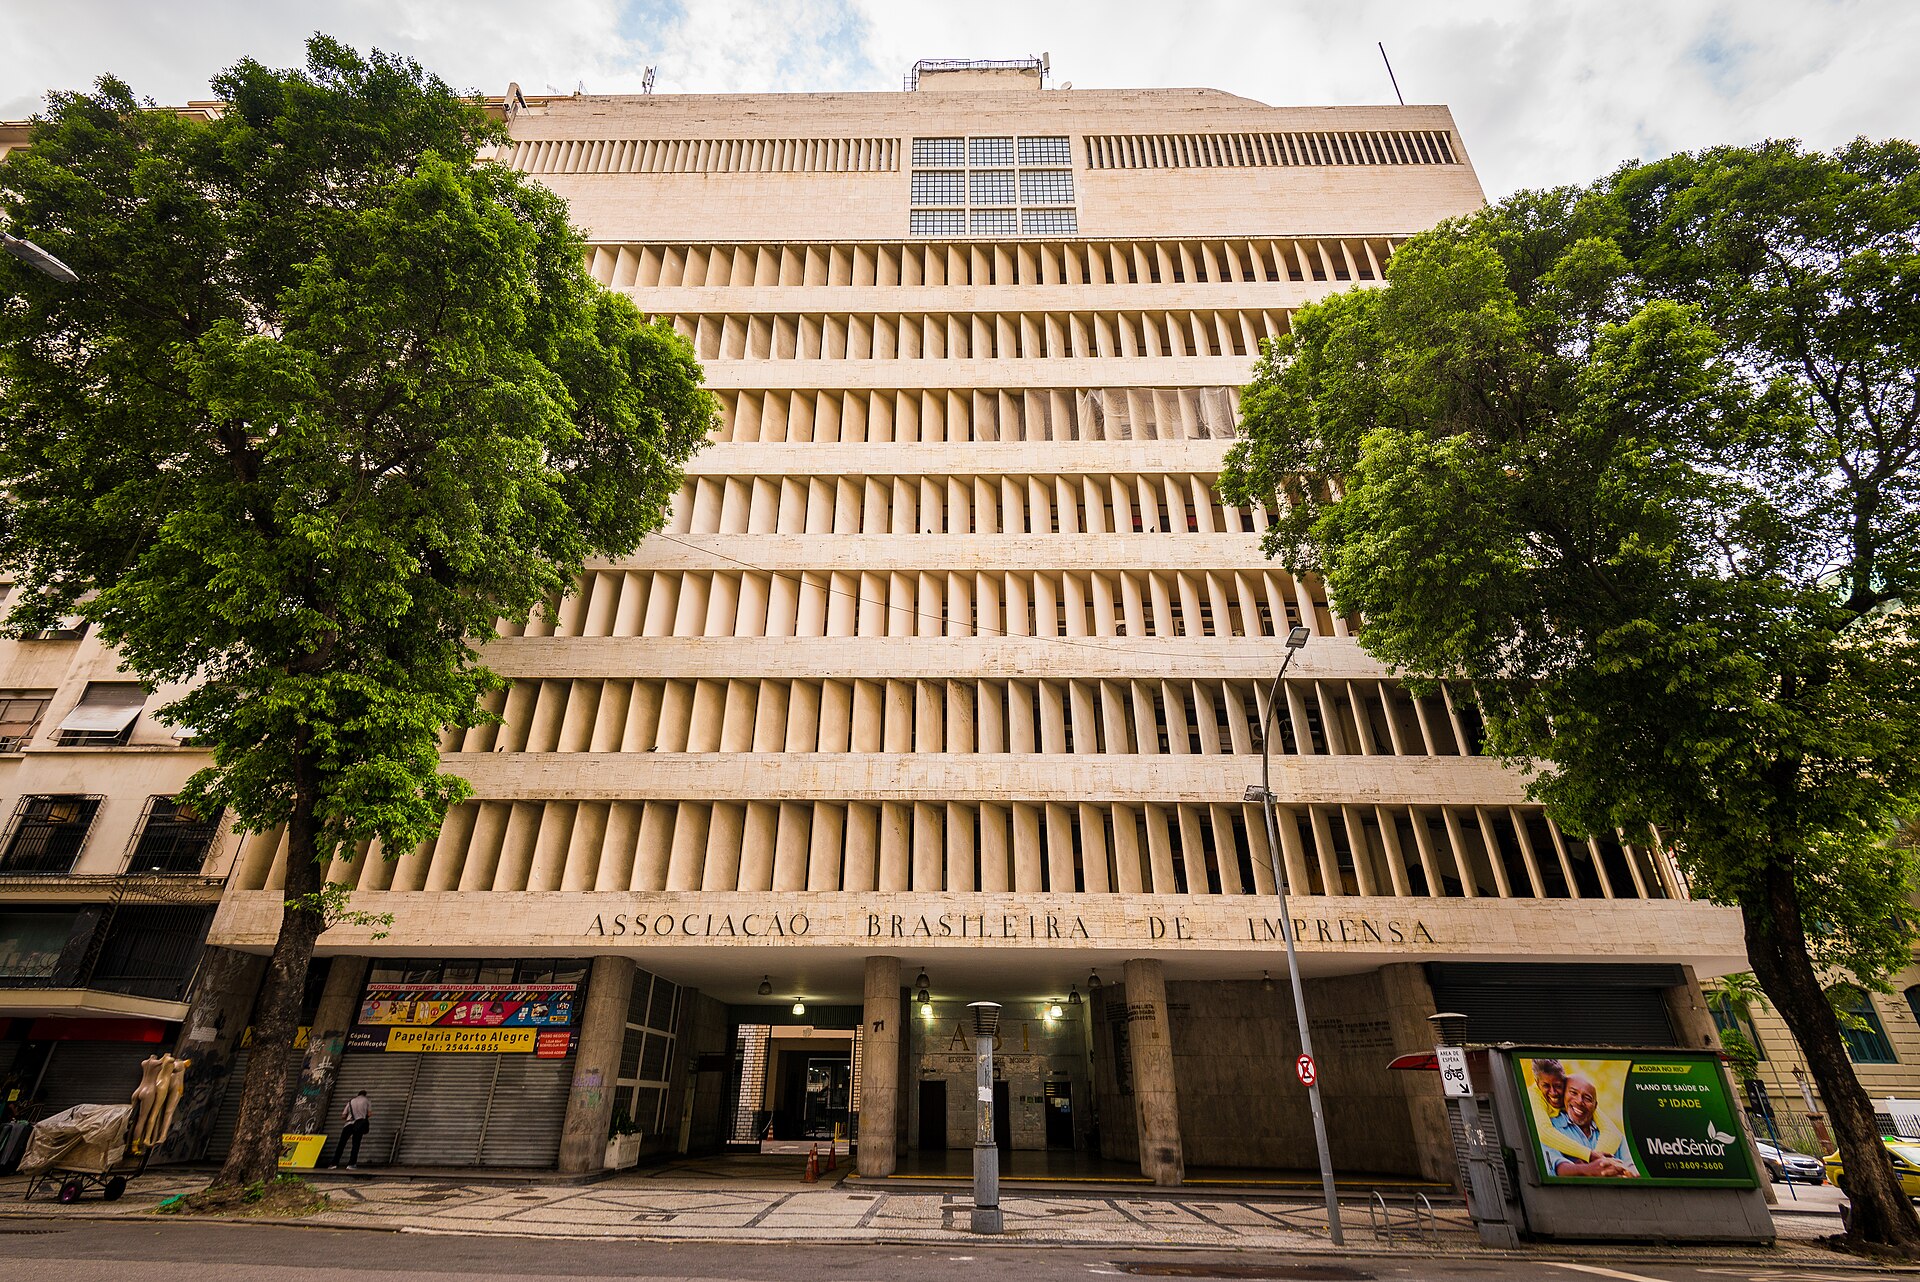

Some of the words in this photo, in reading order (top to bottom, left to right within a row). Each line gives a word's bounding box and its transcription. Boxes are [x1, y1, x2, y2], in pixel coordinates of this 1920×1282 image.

[867, 914, 1090, 939] BRASILEIRA
[1149, 916, 1192, 940] DE
[1247, 917, 1436, 944] IMPRENSA
[873, 1020, 884, 1032] 71
[394, 1031, 451, 1044] Papelaria
[455, 1031, 487, 1042] Porto
[490, 1031, 530, 1044] Alegre
[421, 1043, 442, 1051] Tel.:
[446, 1043, 499, 1051] 2544-4855
[1635, 1083, 1661, 1091] PLANO
[1662, 1083, 1672, 1091] DE
[1674, 1082, 1698, 1092] SAÚDE
[1699, 1084, 1710, 1092] DA
[1669, 1098, 1702, 1108] IDADE
[1646, 1137, 1725, 1157] MedSênior
[1664, 1161, 1679, 1170] (21)
[1680, 1161, 1724, 1170] 3609-3600
